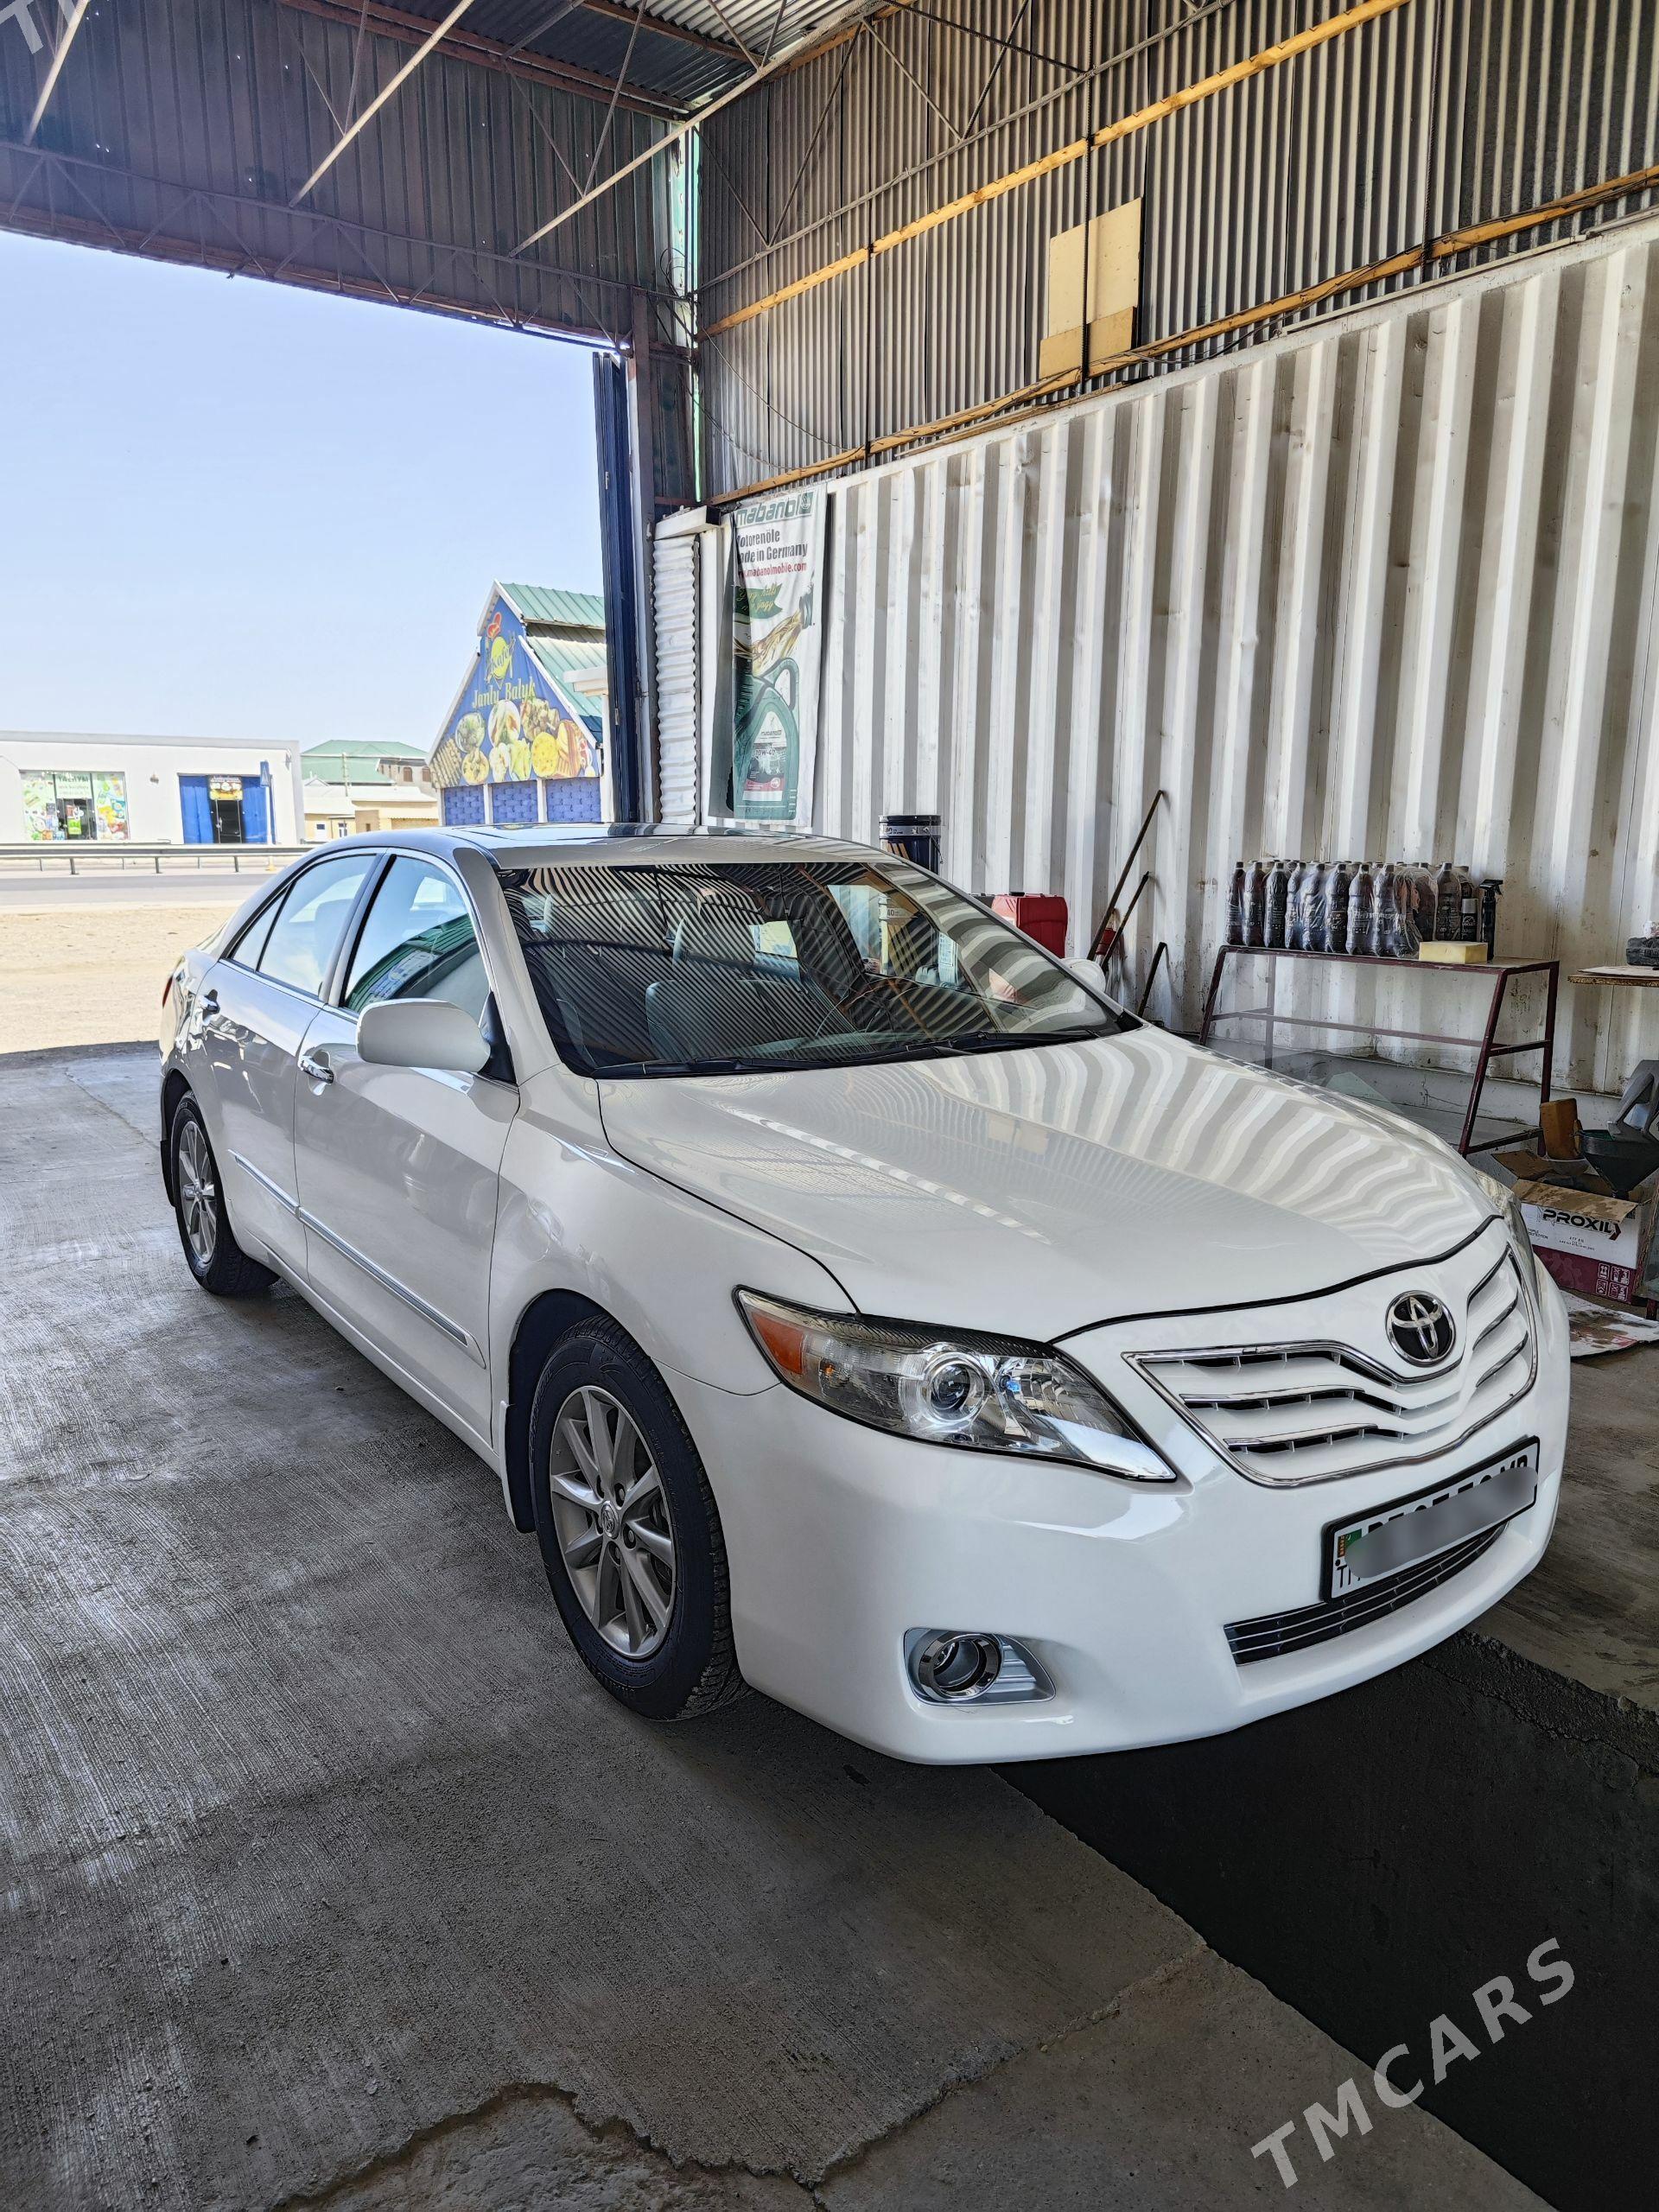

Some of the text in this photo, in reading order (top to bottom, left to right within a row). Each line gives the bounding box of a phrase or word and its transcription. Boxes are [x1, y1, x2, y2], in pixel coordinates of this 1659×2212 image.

[736, 495, 802, 525] mabanol
[757, 550, 765, 562] in
[766, 543, 808, 560] Germany
[472, 676, 536, 709] Janly Balyk
[1542, 1209, 1612, 1233] PROXIL
